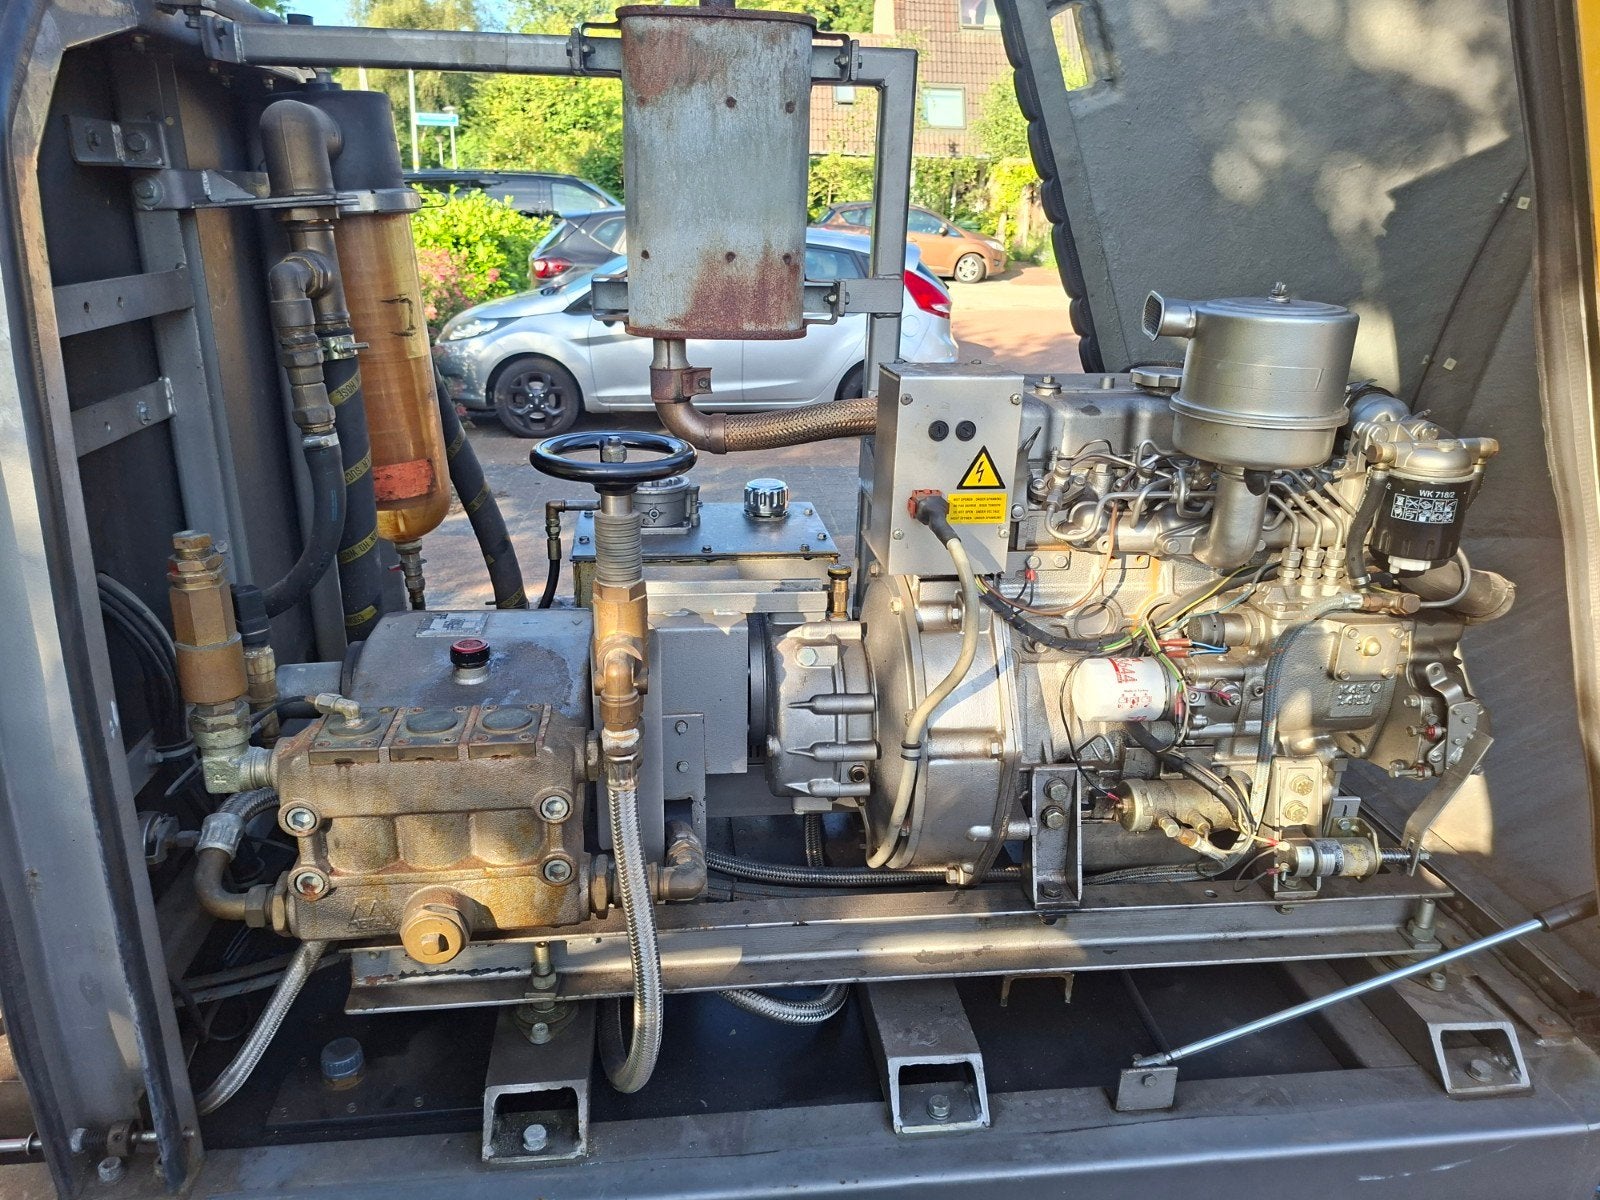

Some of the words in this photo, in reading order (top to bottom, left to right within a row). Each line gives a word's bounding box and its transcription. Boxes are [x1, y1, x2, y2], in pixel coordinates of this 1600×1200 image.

[336, 380, 357, 399] HOSE
[1419, 489, 1433, 497] WK
[1435, 491, 1456, 499] 718/2
